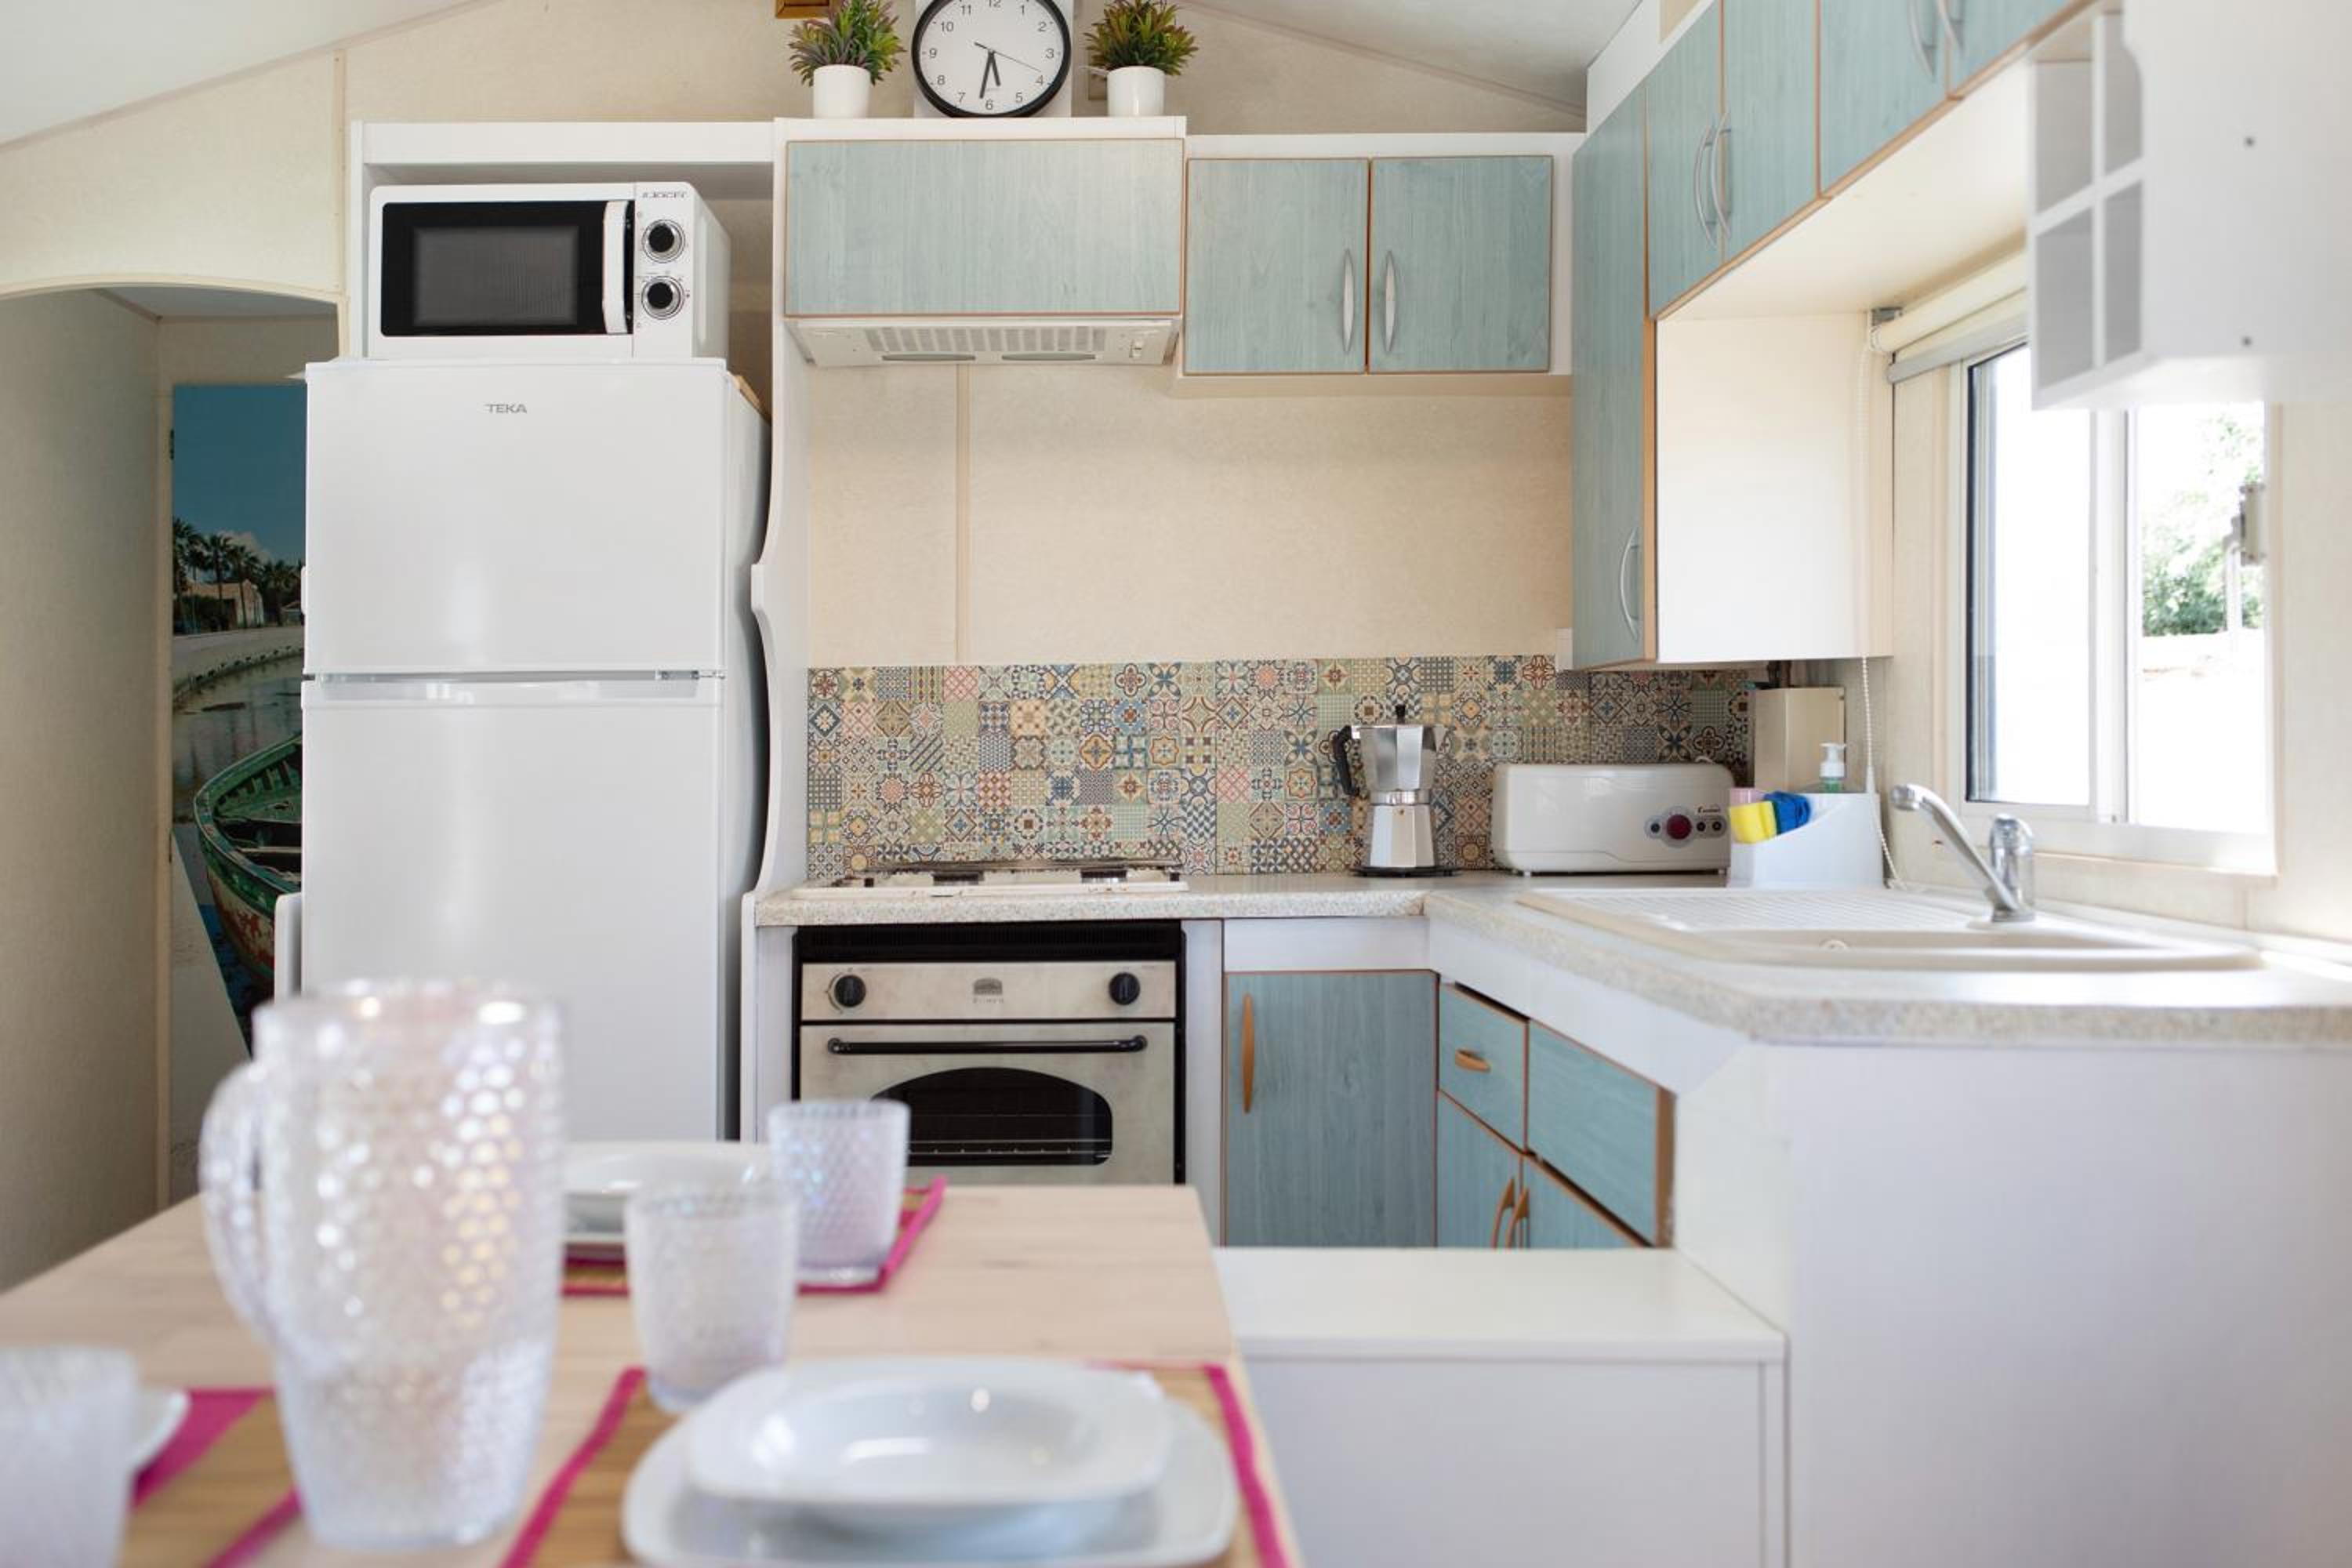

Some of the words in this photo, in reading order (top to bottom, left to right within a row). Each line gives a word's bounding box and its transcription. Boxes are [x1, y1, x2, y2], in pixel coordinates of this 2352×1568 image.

[960, 5, 971, 15] 11
[1019, 4, 1025, 15] 1
[941, 21, 954, 32] 10
[1038, 21, 1047, 32] 2
[929, 48, 938, 59] 9
[1046, 48, 1054, 59] 3
[937, 75, 946, 85] 8
[1036, 75, 1044, 85] 4
[957, 92, 966, 103] 7
[1015, 93, 1023, 103] 5
[985, 99, 993, 110] 6
[485, 403, 528, 414] TEKA
